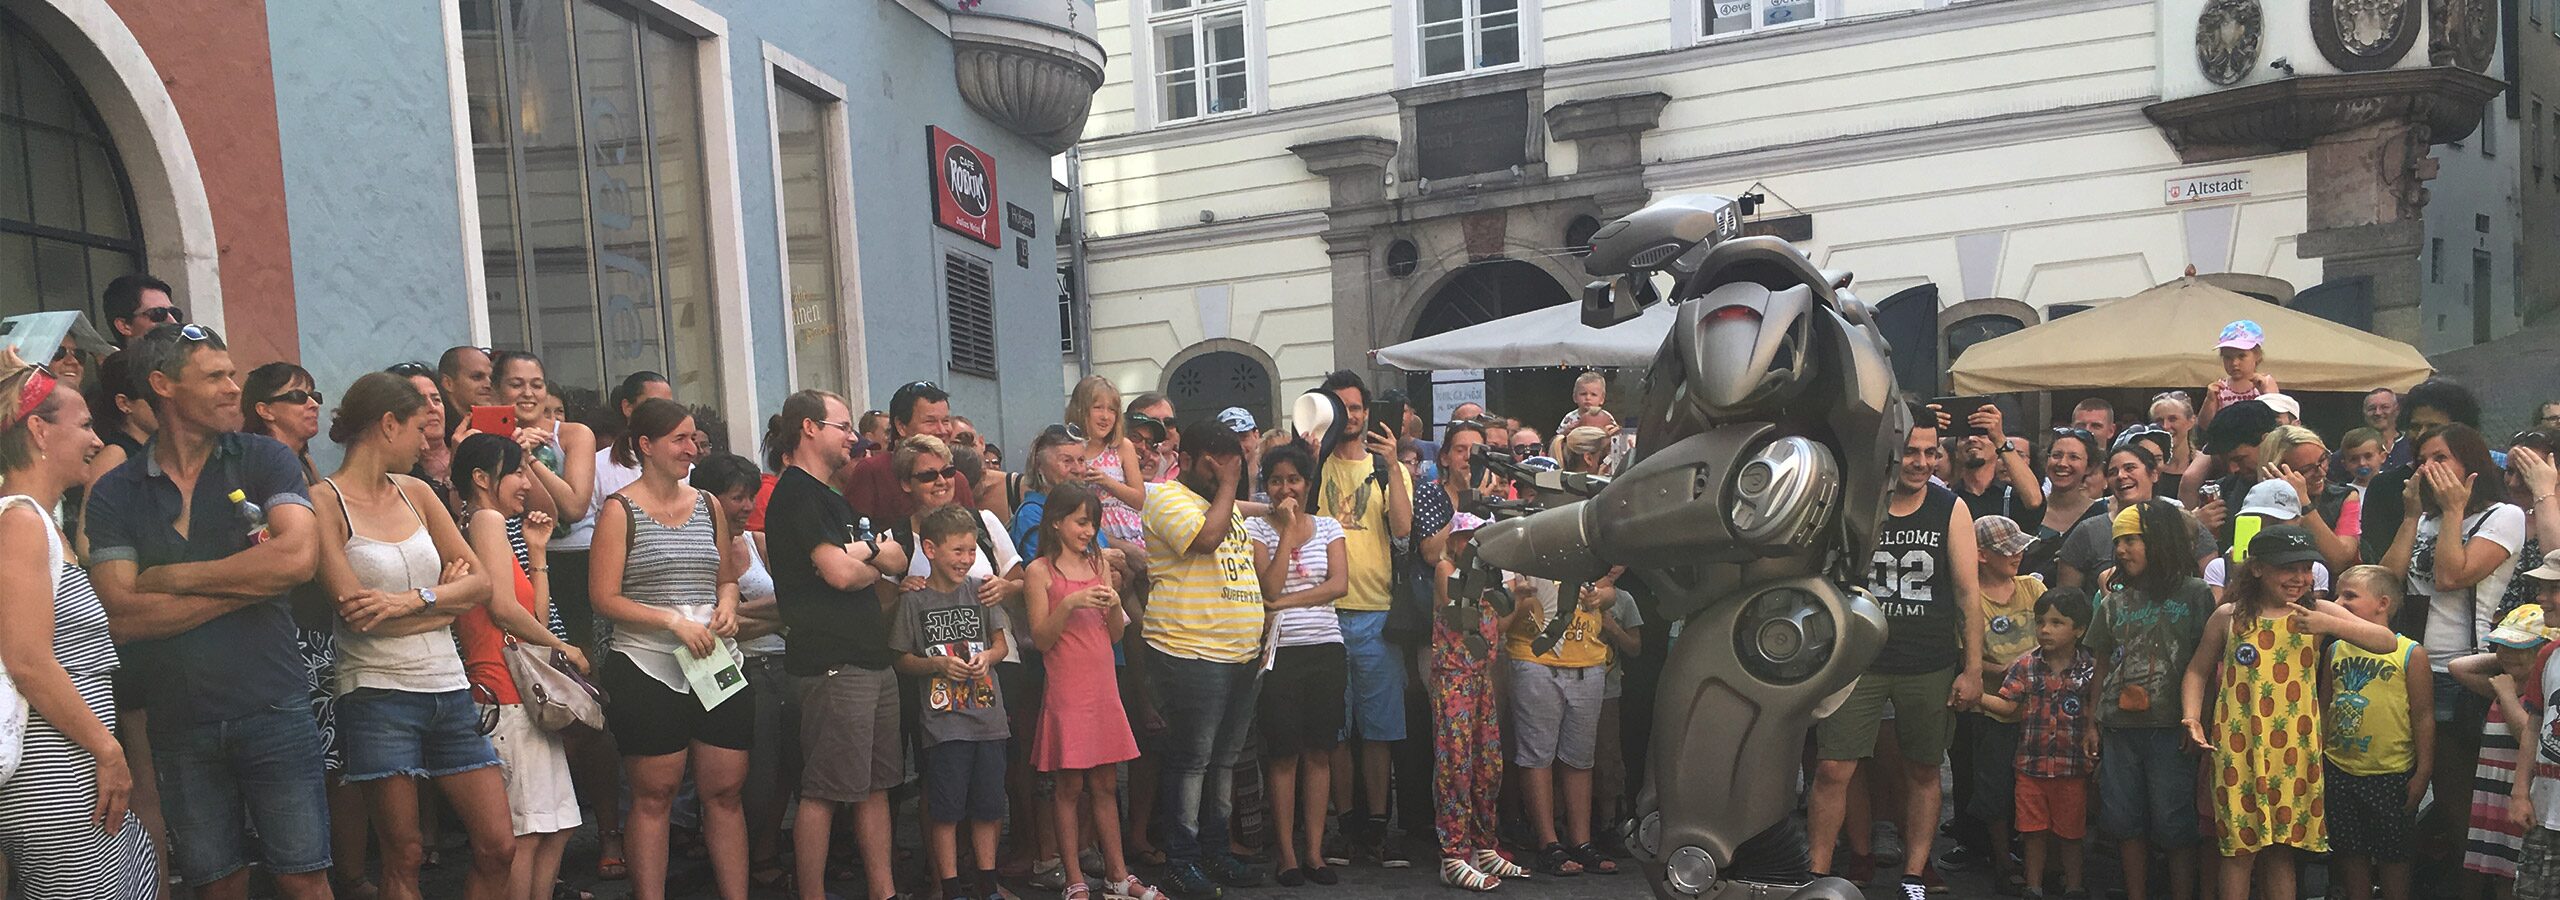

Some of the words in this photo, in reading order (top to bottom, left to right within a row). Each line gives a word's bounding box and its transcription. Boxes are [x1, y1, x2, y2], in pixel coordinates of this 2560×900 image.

[2187, 178, 2243, 196] Altstadt
[925, 608, 980, 627] STAR
[925, 621, 980, 643] WARS
